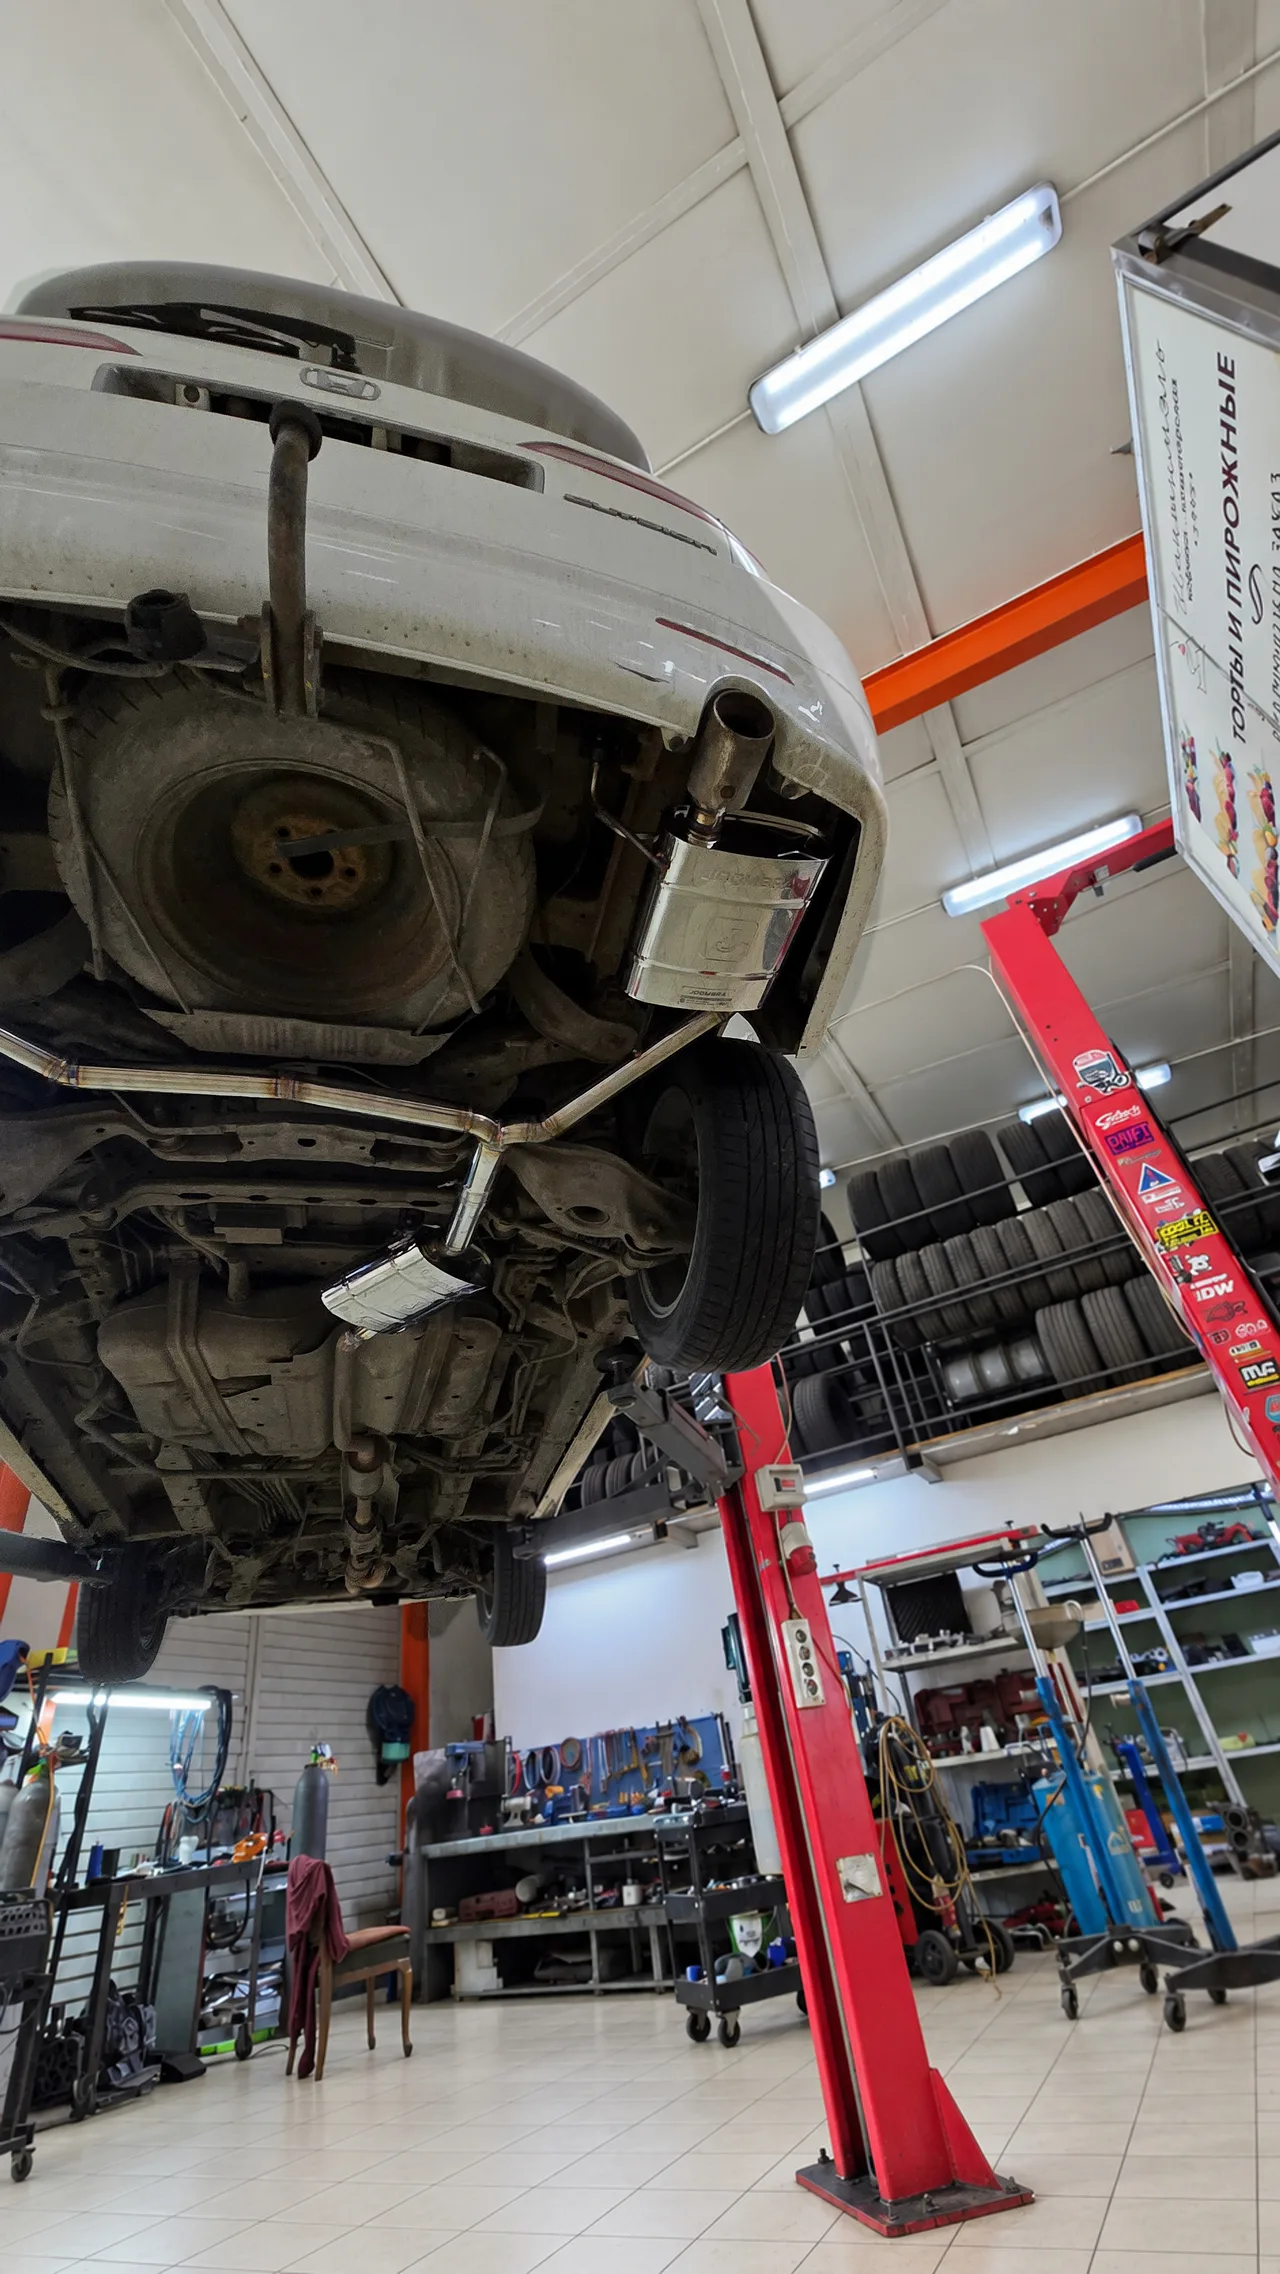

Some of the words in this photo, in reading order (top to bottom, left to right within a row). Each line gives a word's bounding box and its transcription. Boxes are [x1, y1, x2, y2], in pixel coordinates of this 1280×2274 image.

[1217, 352, 1242, 608] ПИРОЖНЫЕ
[1229, 612, 1245, 642] И
[1229, 644, 1247, 744] ТОРТЫ
